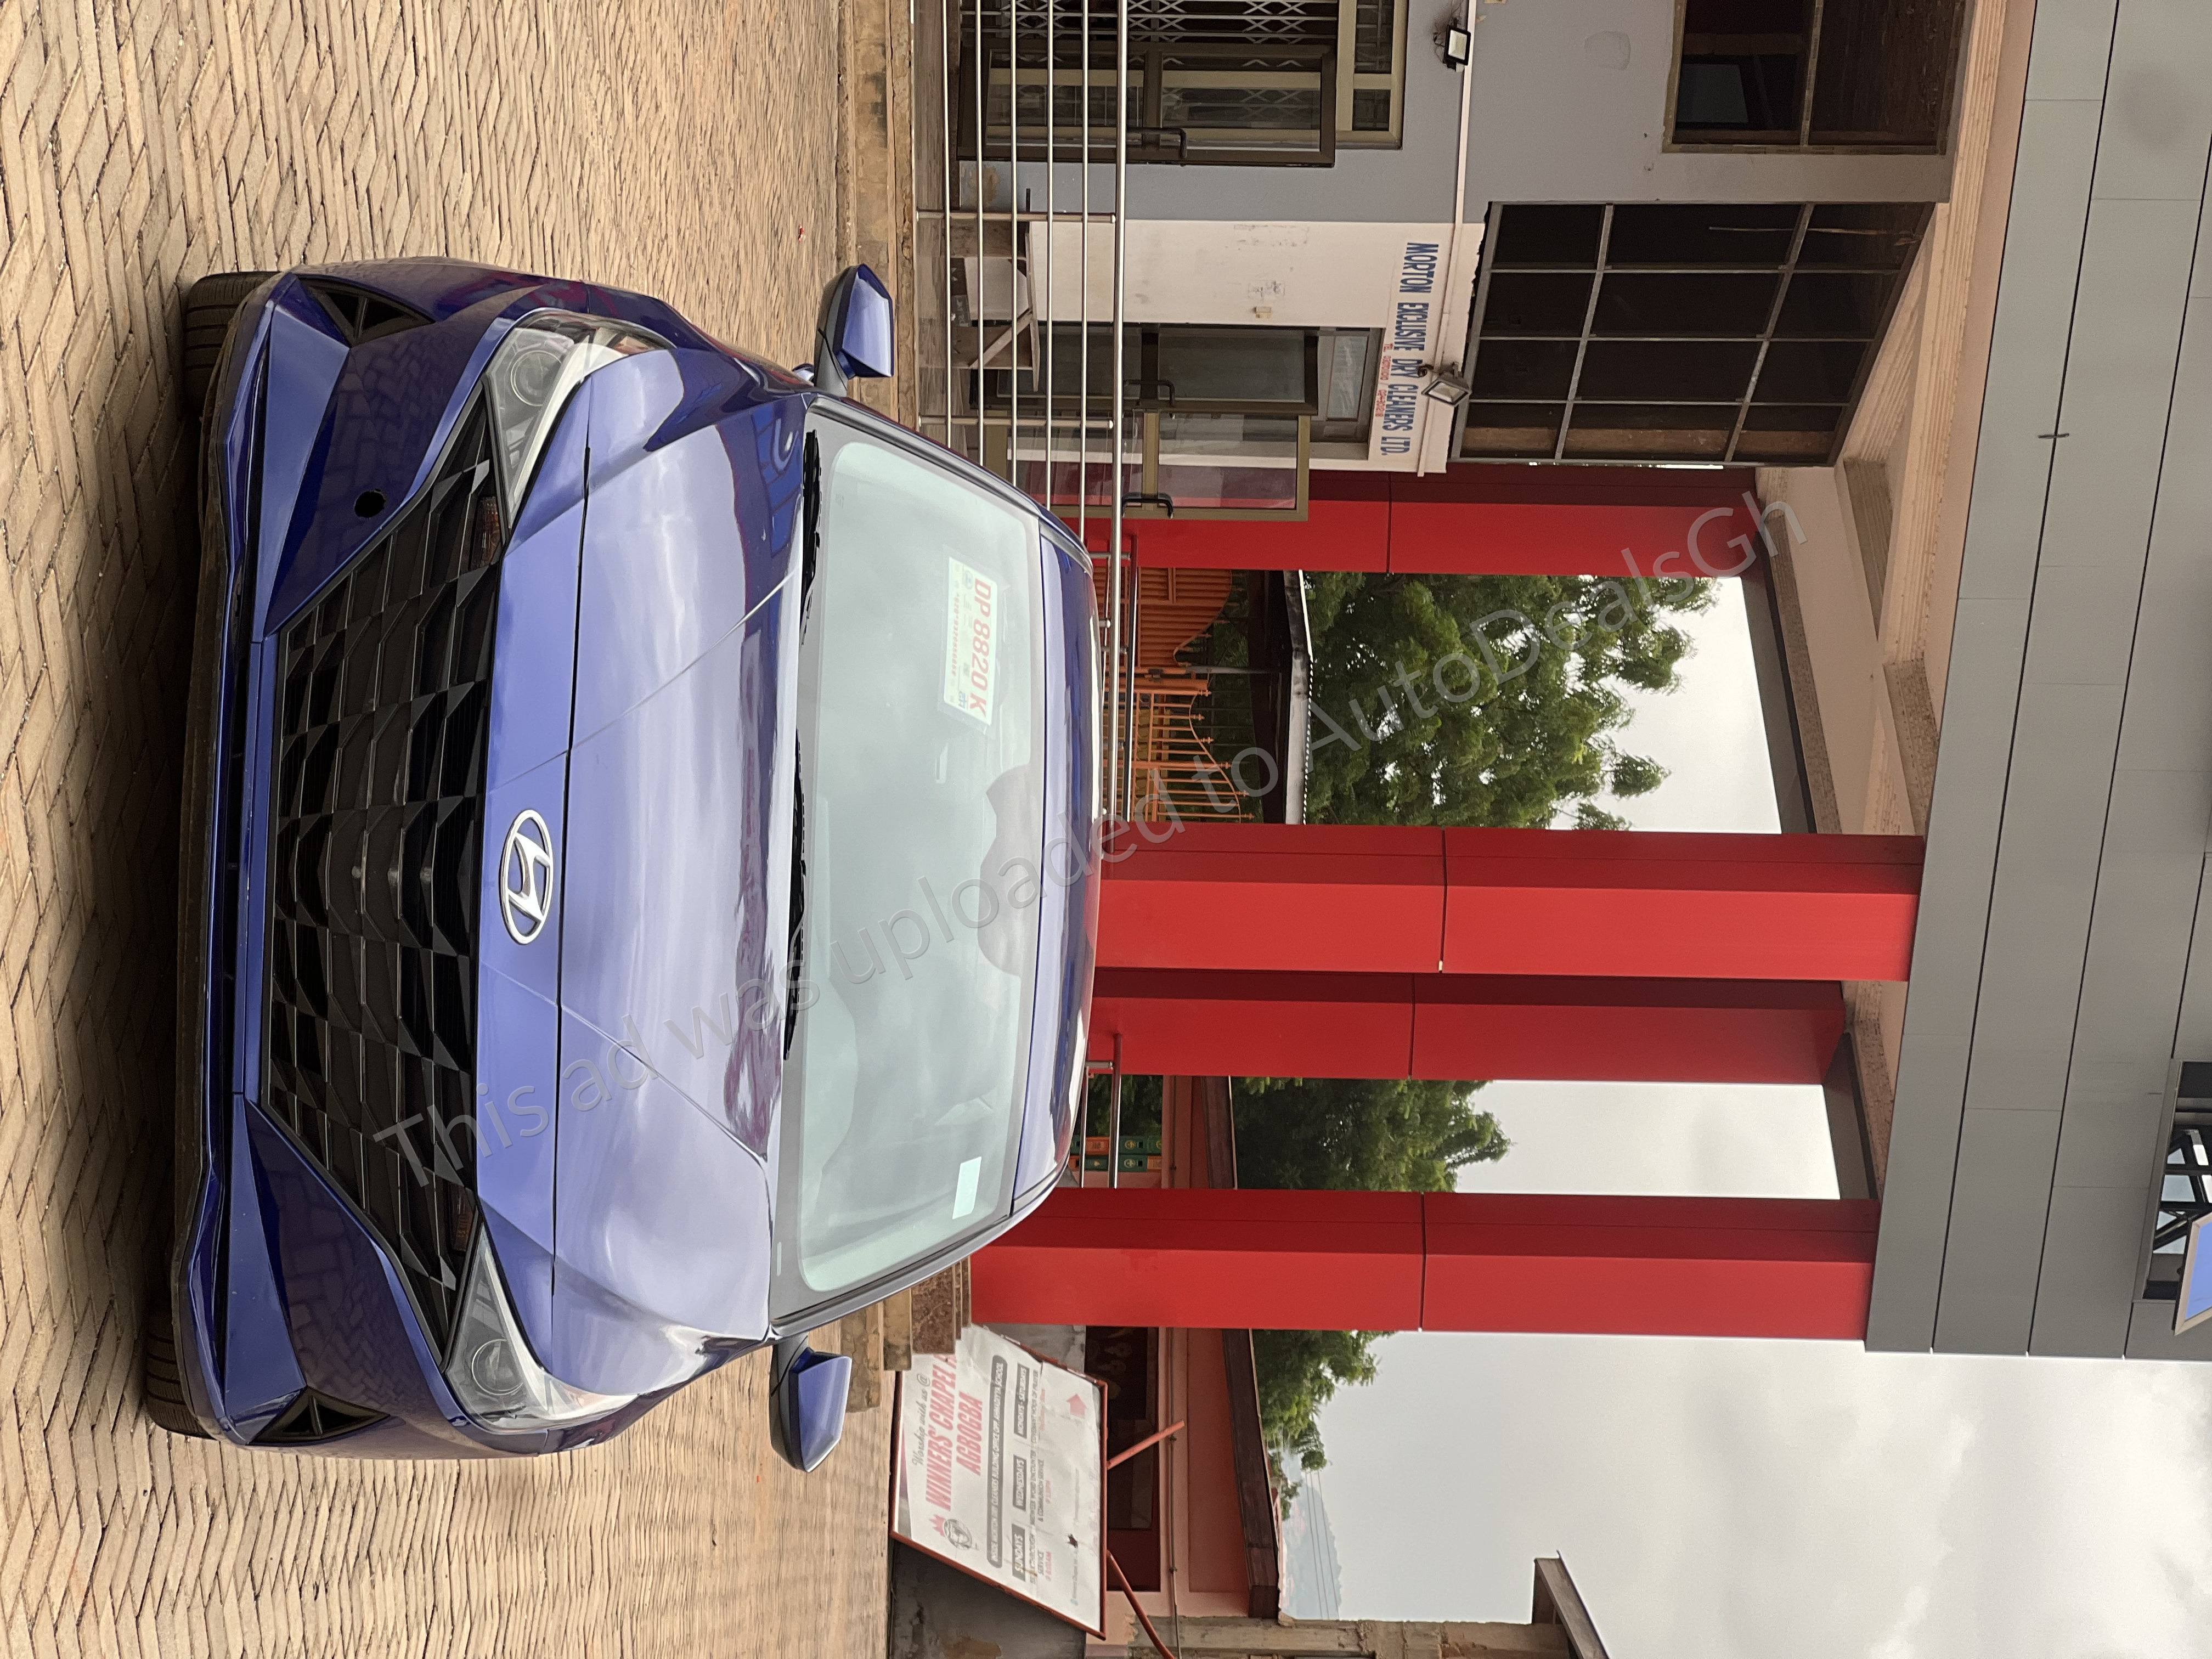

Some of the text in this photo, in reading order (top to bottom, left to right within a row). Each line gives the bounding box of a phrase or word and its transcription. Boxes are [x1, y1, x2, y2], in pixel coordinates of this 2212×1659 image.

[1380, 242, 1438, 455] MORTON EXCLUSIVE DRY CLEANERS LTD.
[969, 578, 991, 717] DP 8820 K
[916, 1401, 927, 1424] with
[921, 1389, 928, 1400] us
[928, 1364, 956, 1431] CHAPEL
[912, 1428, 929, 1466] Worship
[956, 1390, 983, 1476] AGBOGBA
[926, 1423, 953, 1512] WINNERS'
[1015, 1459, 1025, 1507] WEDNESDAYS
[1014, 1533, 1024, 1574] SUNDAYS
